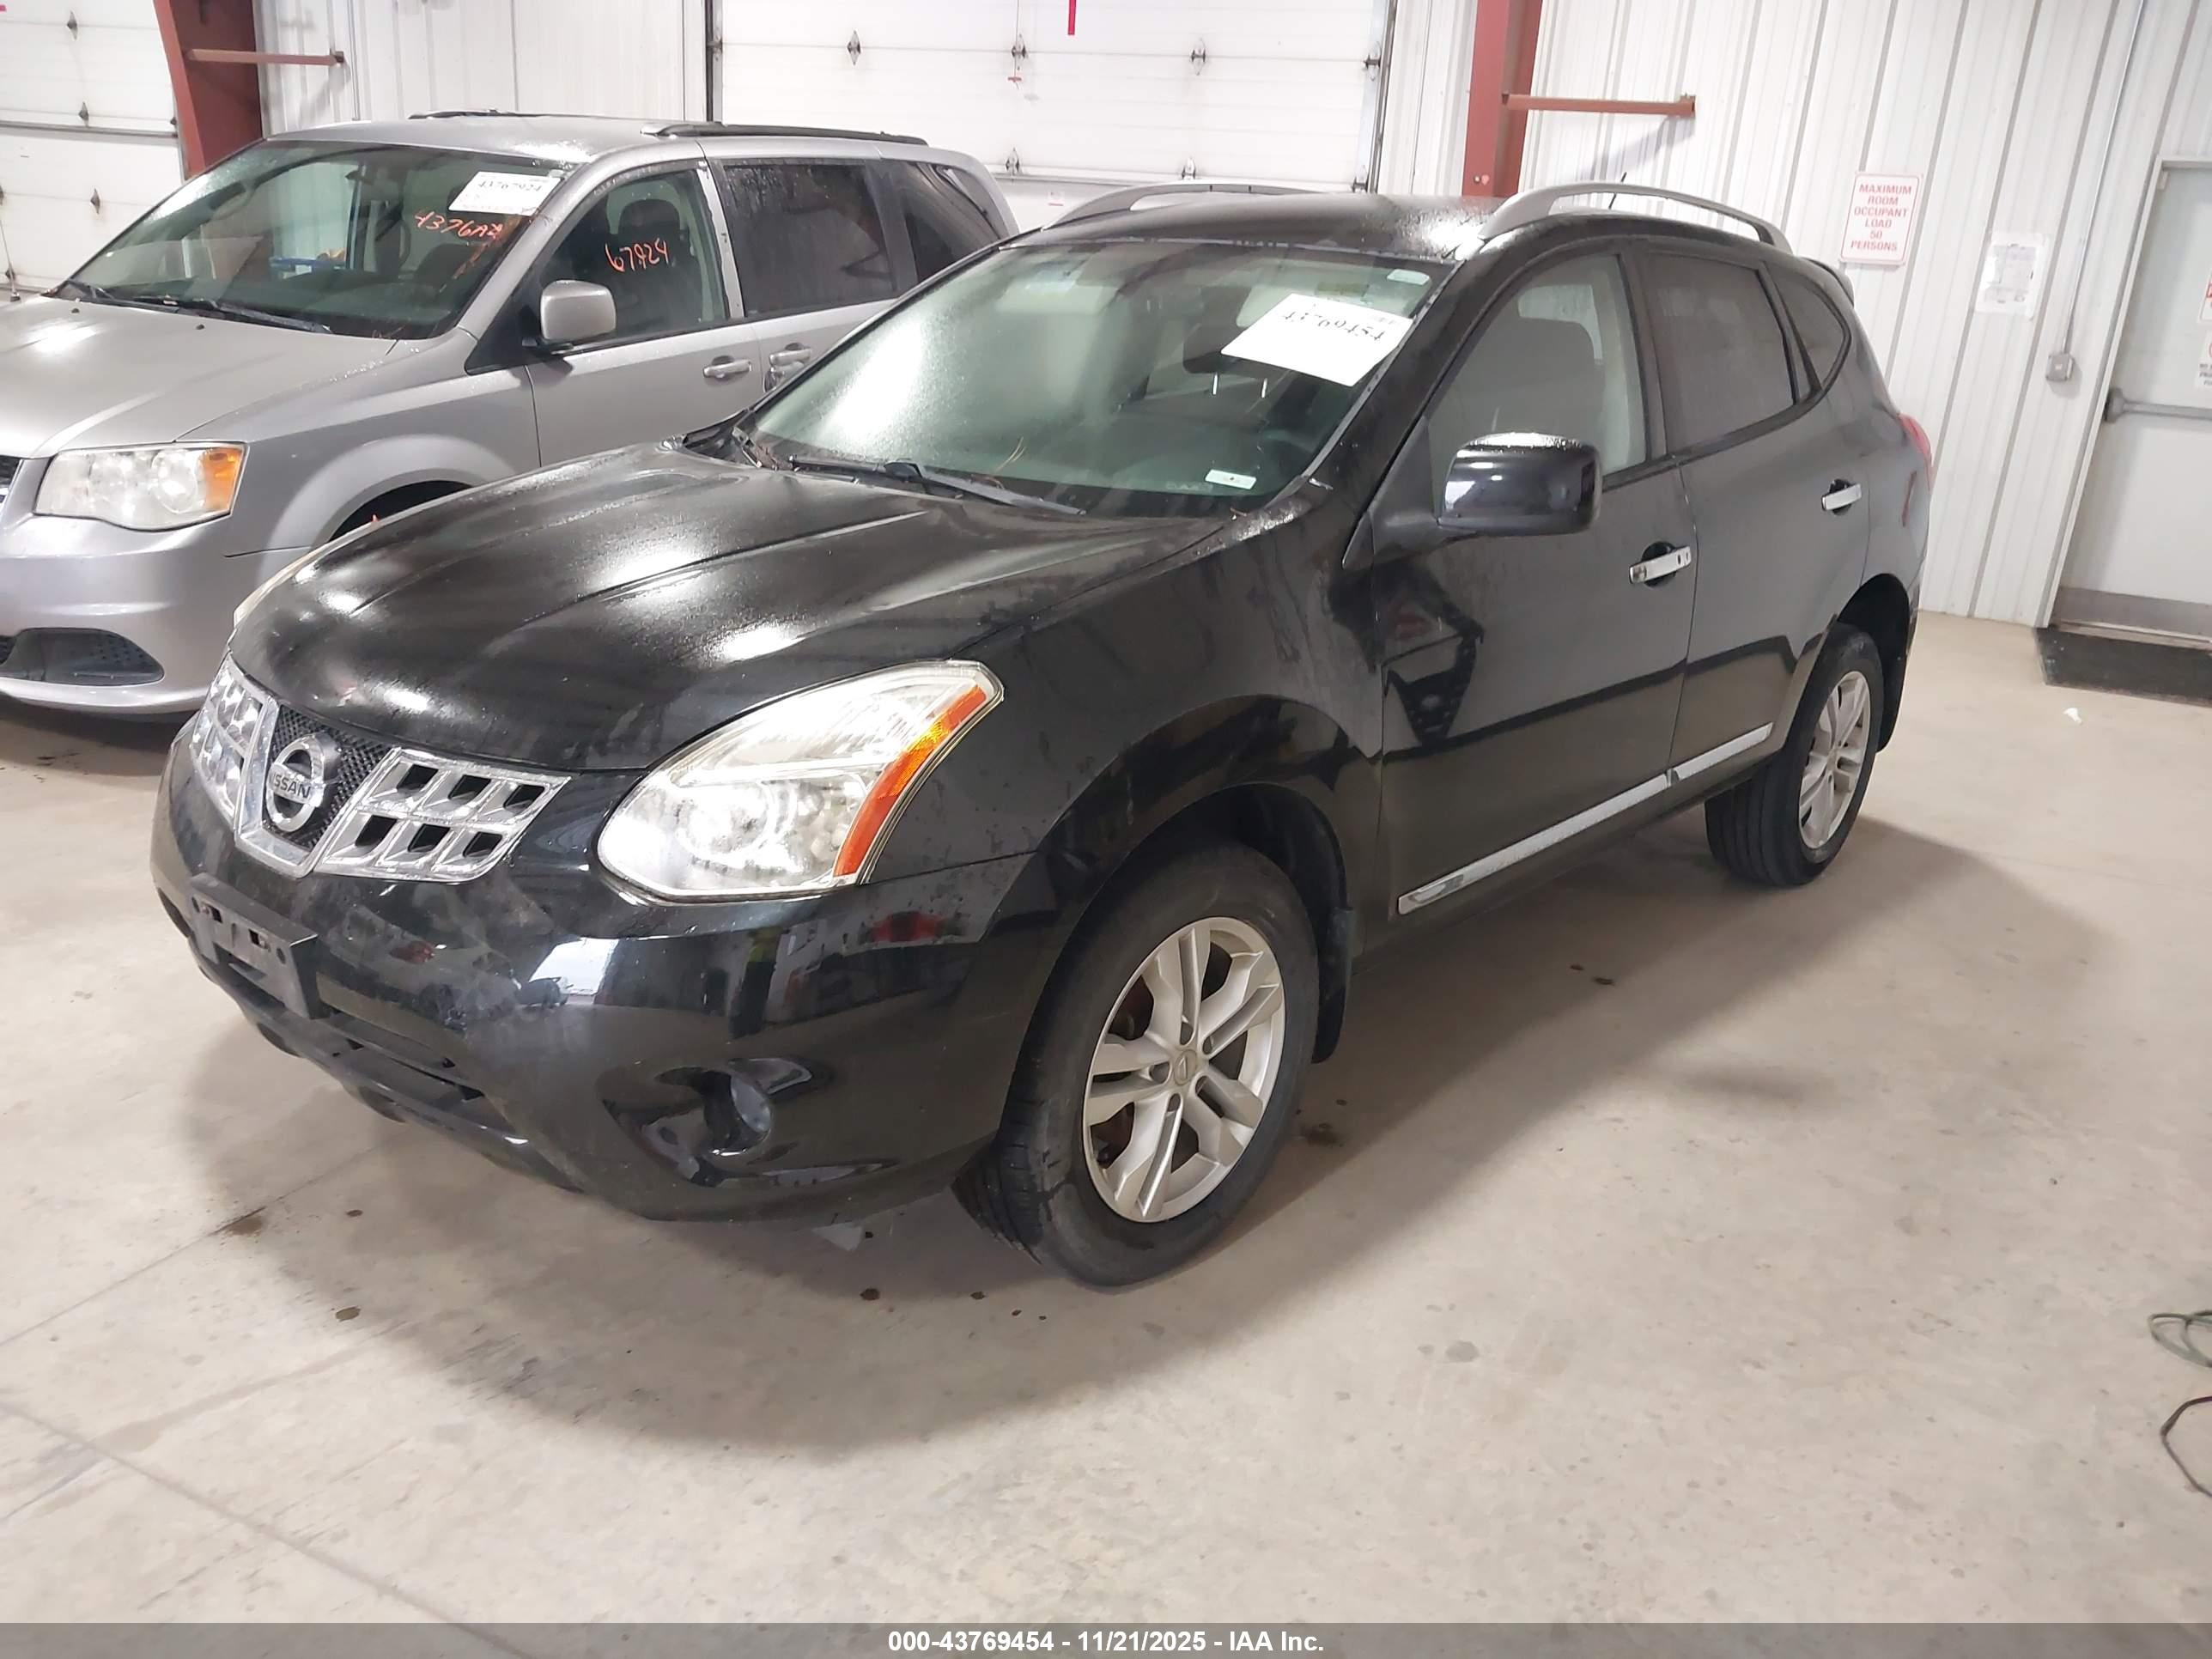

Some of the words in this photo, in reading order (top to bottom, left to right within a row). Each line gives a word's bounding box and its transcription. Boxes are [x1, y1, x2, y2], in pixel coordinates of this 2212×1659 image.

[1859, 184, 1911, 195] MAXIMUM
[1868, 196, 1899, 206] ROOM
[1854, 206, 1907, 217] OCCUPANT
[1865, 218, 1892, 228] LOAD
[1869, 230, 1882, 240] 50
[1850, 240, 1897, 252] PERSONS
